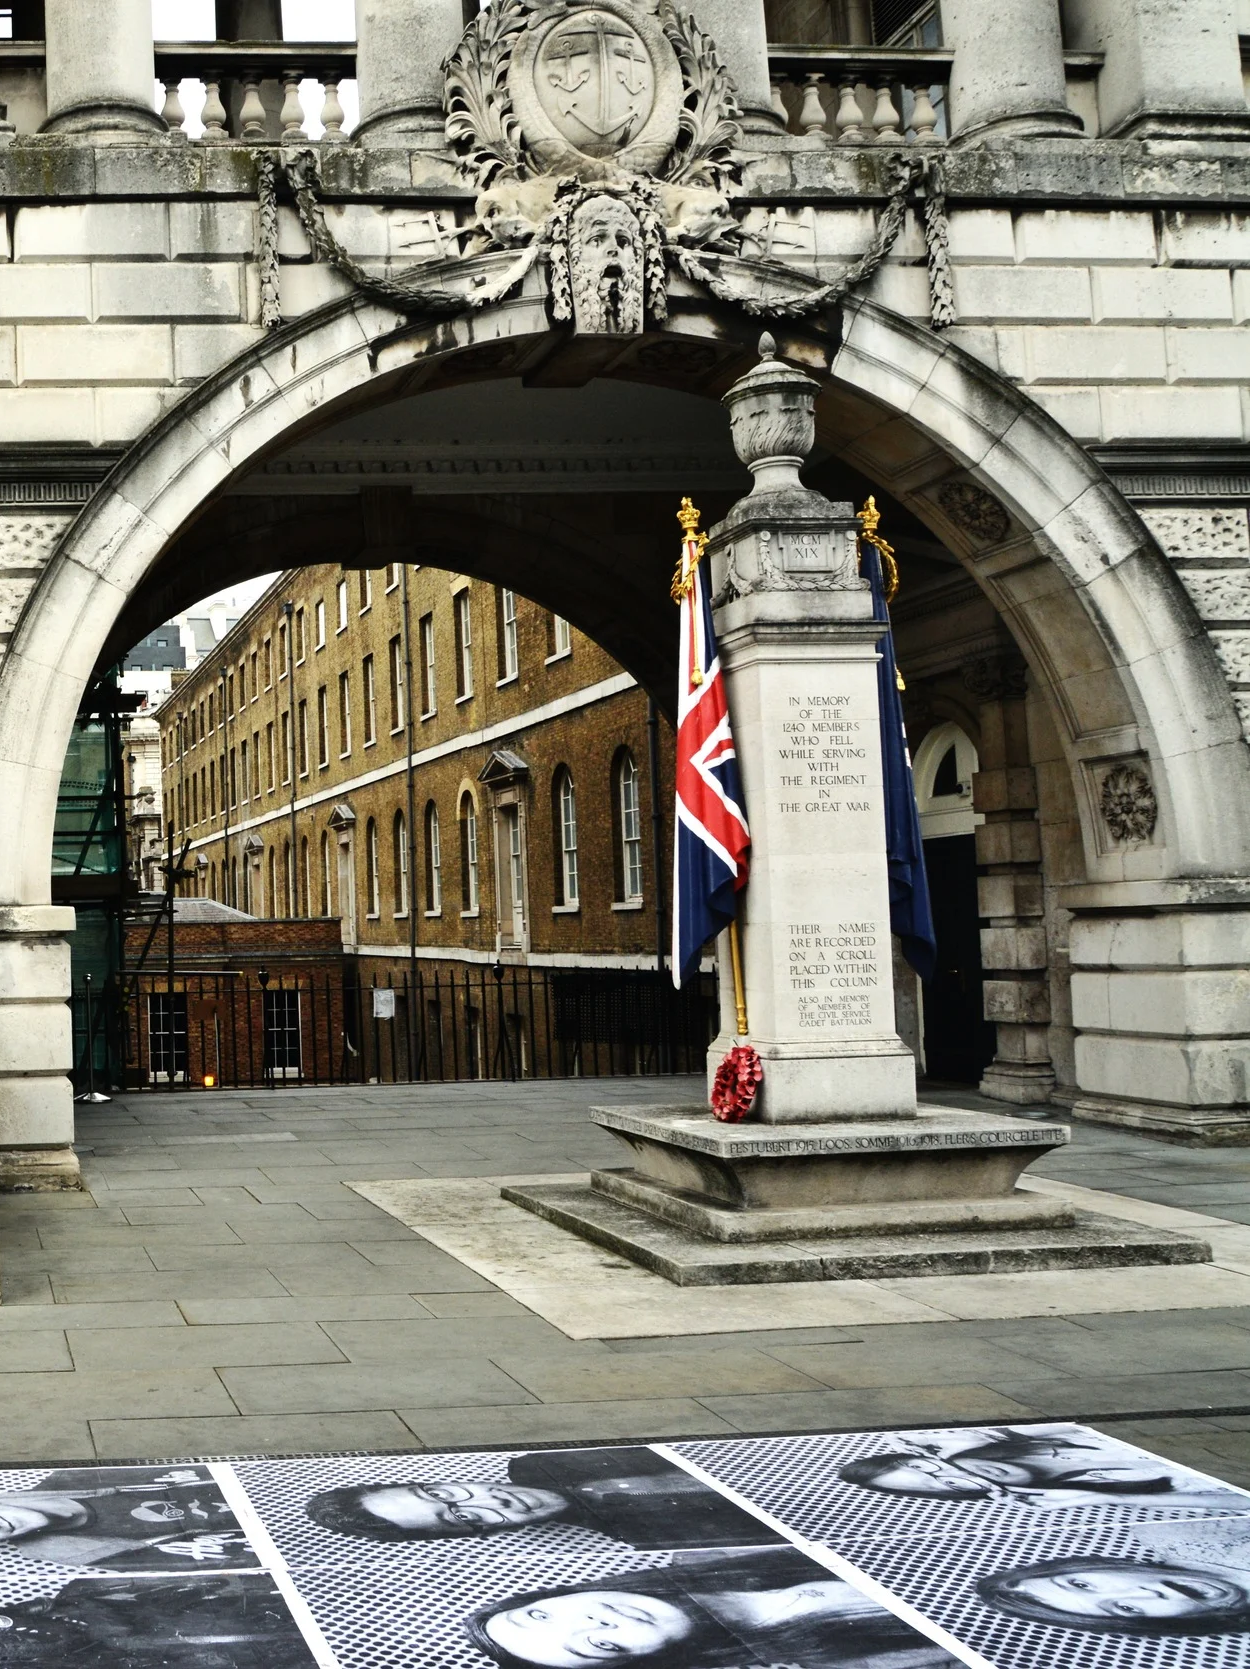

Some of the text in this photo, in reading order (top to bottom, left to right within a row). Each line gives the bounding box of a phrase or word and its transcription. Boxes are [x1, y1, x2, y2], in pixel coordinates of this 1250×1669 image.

[790, 534, 821, 545] MCM
[795, 547, 818, 559] XIX
[789, 696, 850, 706] IN MEMORY
[799, 709, 842, 719] OF THE
[782, 721, 860, 733] 1240 MEMBERS
[790, 735, 853, 746] WHO FELL
[779, 748, 866, 759] WHILE SERVING
[807, 762, 839, 772] WITH
[780, 774, 867, 786] THE REGIMENT
[818, 789, 830, 799] IN
[778, 801, 871, 813] THE GREAT WAR
[788, 922, 876, 935] THEIR NAMES
[789, 936, 876, 949] ARE RECORDED
[789, 949, 876, 962] ON A SCROLL
[789, 963, 877, 976] PLACED WITHIN
[791, 976, 878, 989] THIS COLUMN
[798, 995, 870, 1004] ALSO IN MEMORY
[798, 1004, 809, 1012] OF
[817, 1003, 852, 1011] MEMBERS
[799, 1010, 871, 1020] THE CIVIL SERVICE
[798, 1018, 872, 1028] CADET BATTALION
[729, 1140, 793, 1154] FESTUBERT
[855, 1134, 894, 1148] SOMME
[944, 1133, 976, 1145] FLERS
